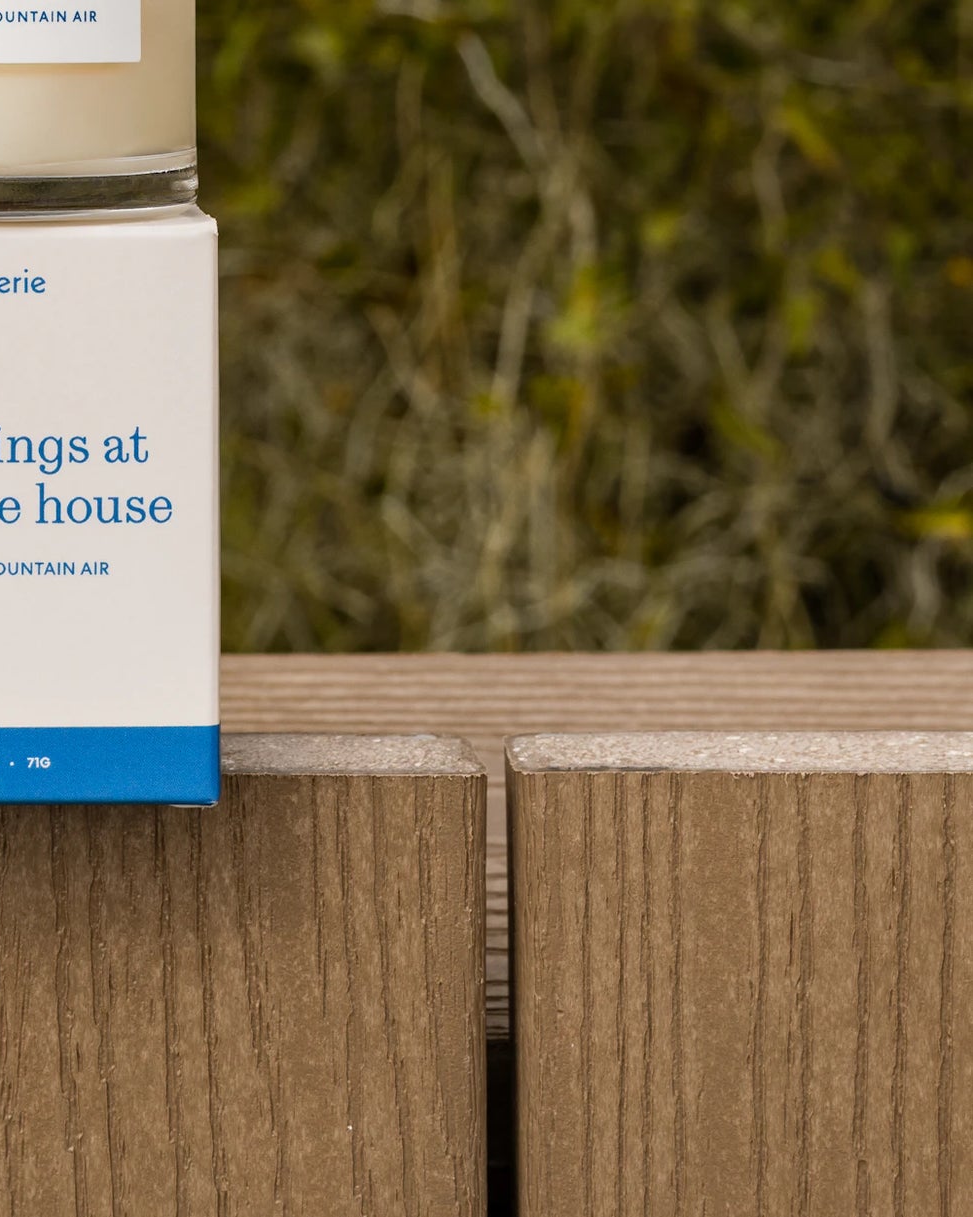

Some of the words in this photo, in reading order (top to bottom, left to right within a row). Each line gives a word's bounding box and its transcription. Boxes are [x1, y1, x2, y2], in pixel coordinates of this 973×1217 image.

[72, 10, 98, 23] AIR
[102, 425, 149, 464] at
[34, 481, 173, 525] house
[80, 561, 110, 576] AIR
[26, 756, 52, 769] 71G
